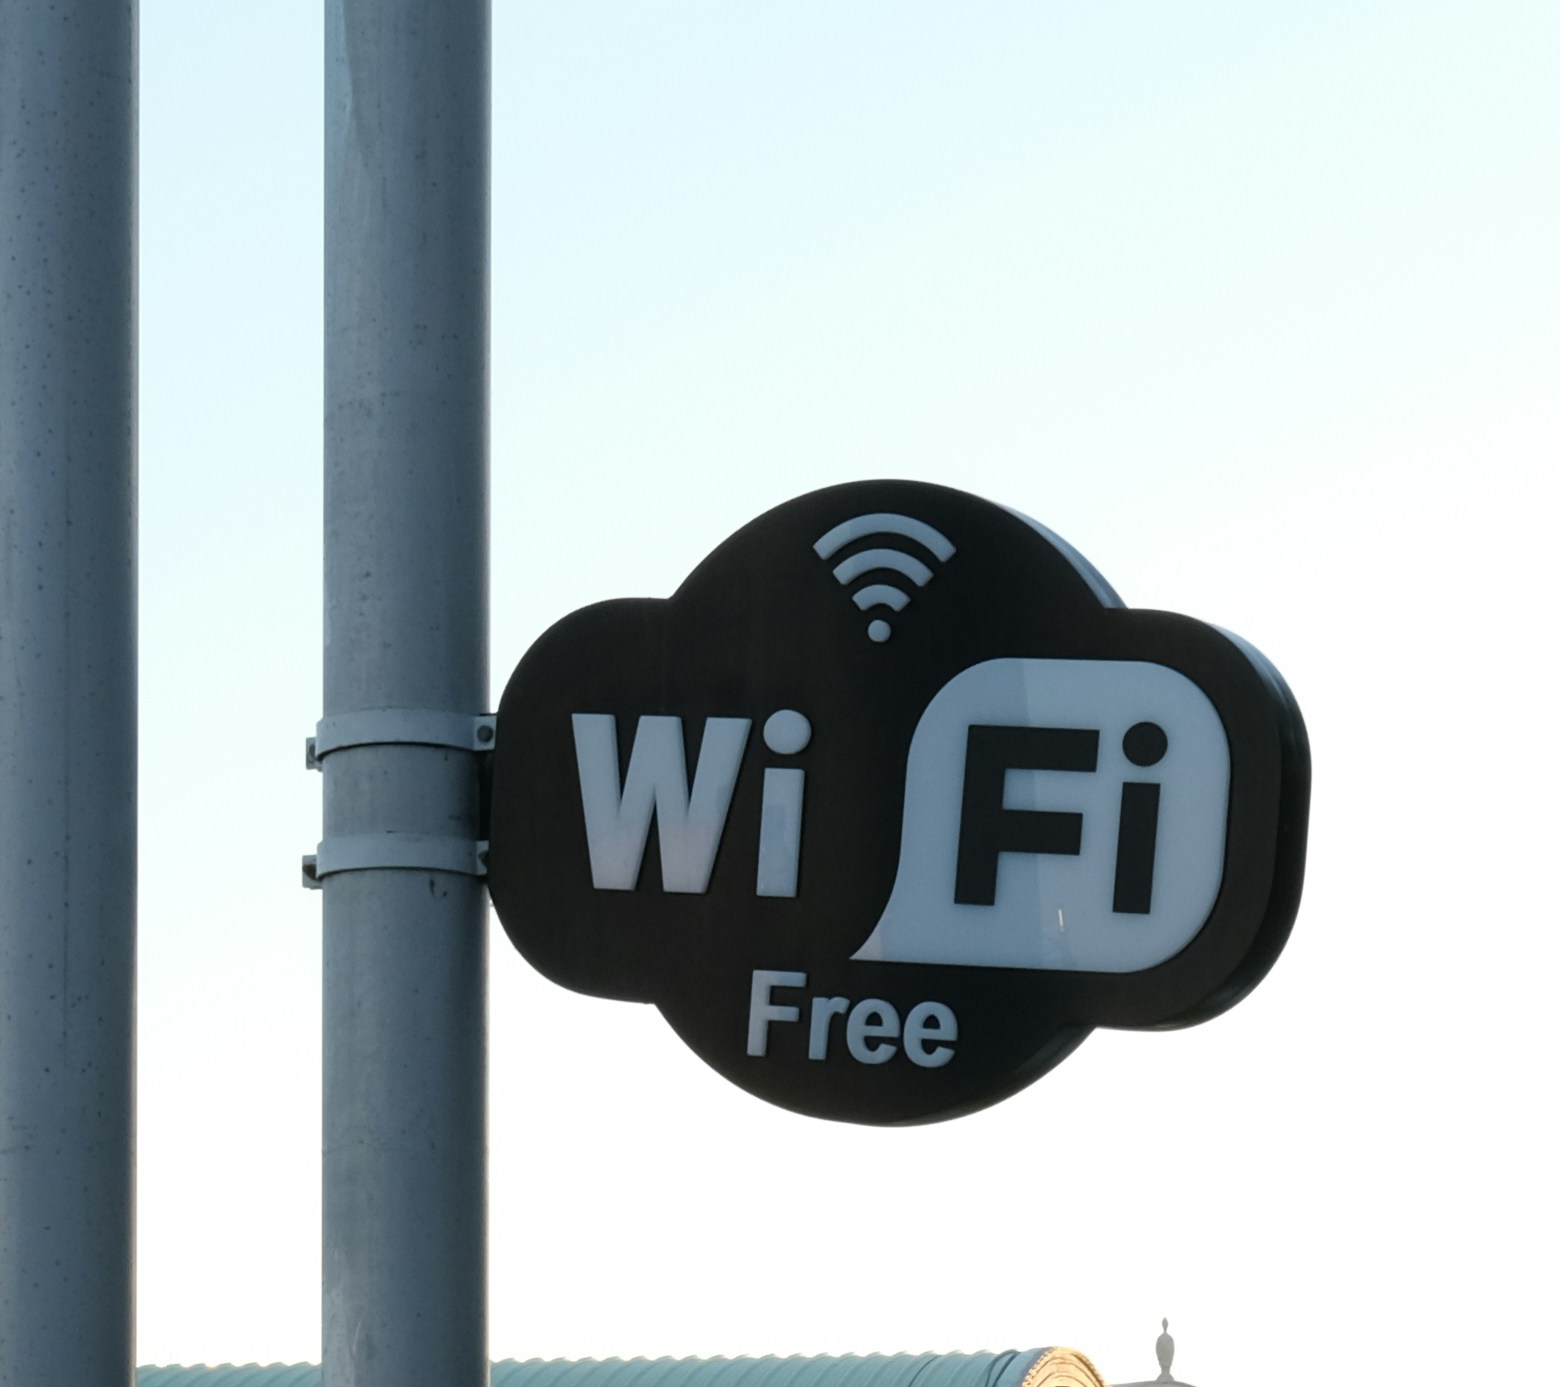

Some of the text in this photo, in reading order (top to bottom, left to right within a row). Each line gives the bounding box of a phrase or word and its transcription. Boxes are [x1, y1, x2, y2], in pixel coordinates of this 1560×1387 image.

[571, 708, 1169, 916] Wi Fi
[746, 969, 958, 1069] Free
